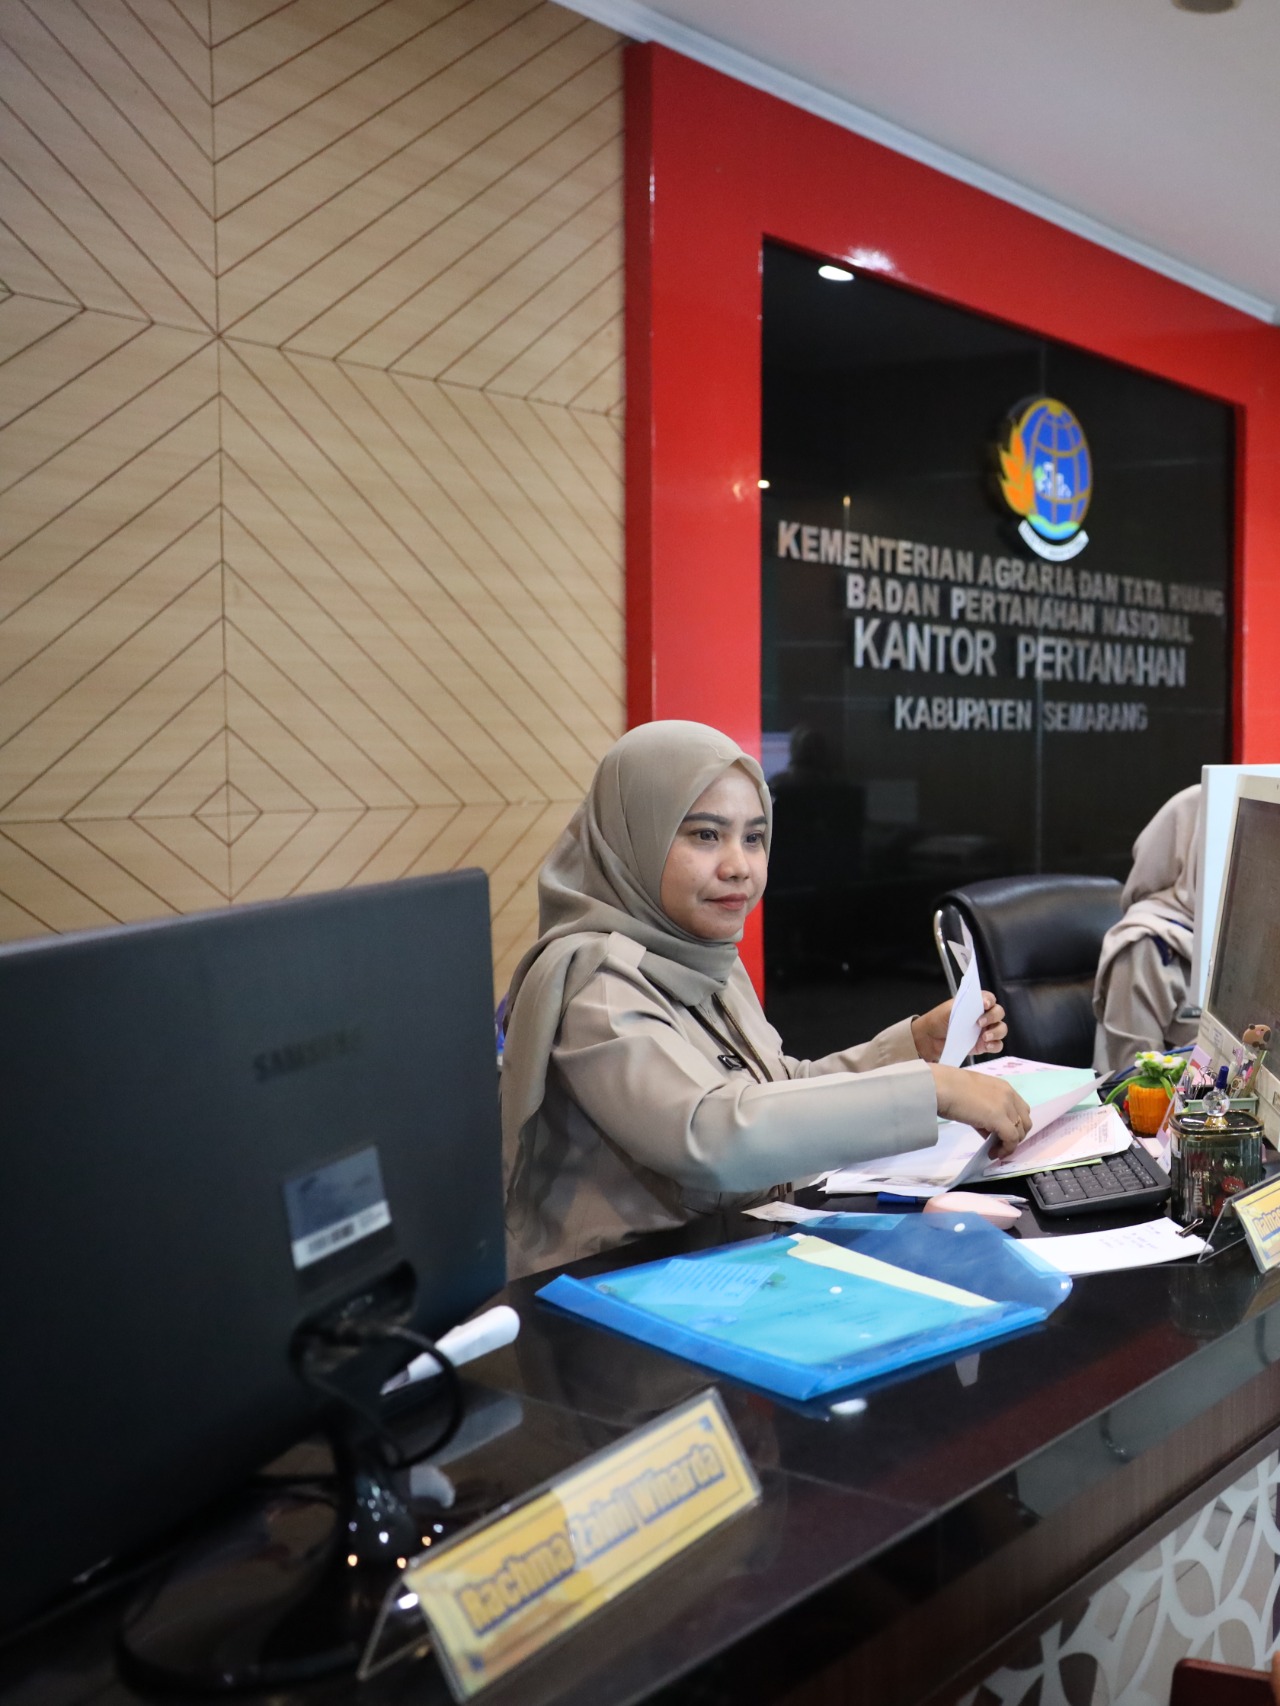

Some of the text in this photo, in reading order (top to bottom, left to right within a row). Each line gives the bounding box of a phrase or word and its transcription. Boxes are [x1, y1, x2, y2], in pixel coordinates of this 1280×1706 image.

[777, 521, 975, 583] KEMENTERIAN
[977, 557, 1076, 597] AGRARIA
[1078, 571, 1119, 599] DAN
[1123, 576, 1165, 606] TATA
[846, 573, 1194, 643] BADAN PERTANAHAN NASIONAL
[853, 616, 1187, 687] KANTOR PERTANAHAN
[894, 695, 1148, 732] KABUPATEN SEMARANG
